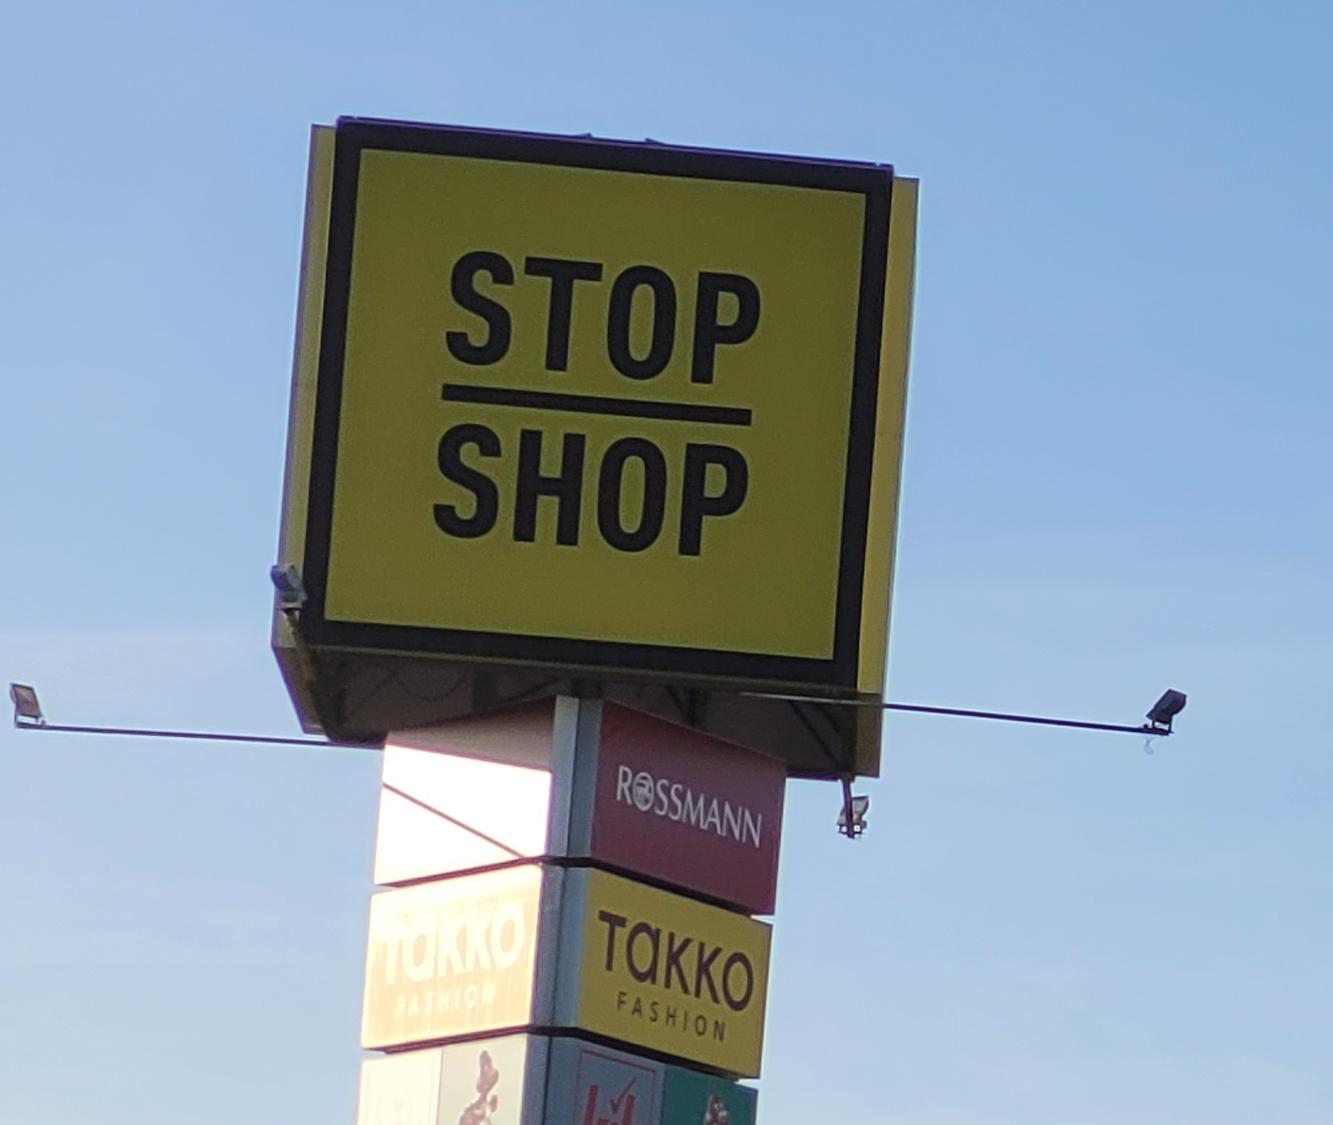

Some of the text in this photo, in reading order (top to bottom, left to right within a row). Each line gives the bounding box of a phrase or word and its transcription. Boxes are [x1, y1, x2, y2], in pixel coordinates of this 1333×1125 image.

[445, 251, 762, 385] STOP
[432, 423, 749, 557] SHOP
[616, 764, 763, 849] ROSSMANN
[395, 980, 497, 1018] FASHION
[616, 991, 727, 1042] FASHION
